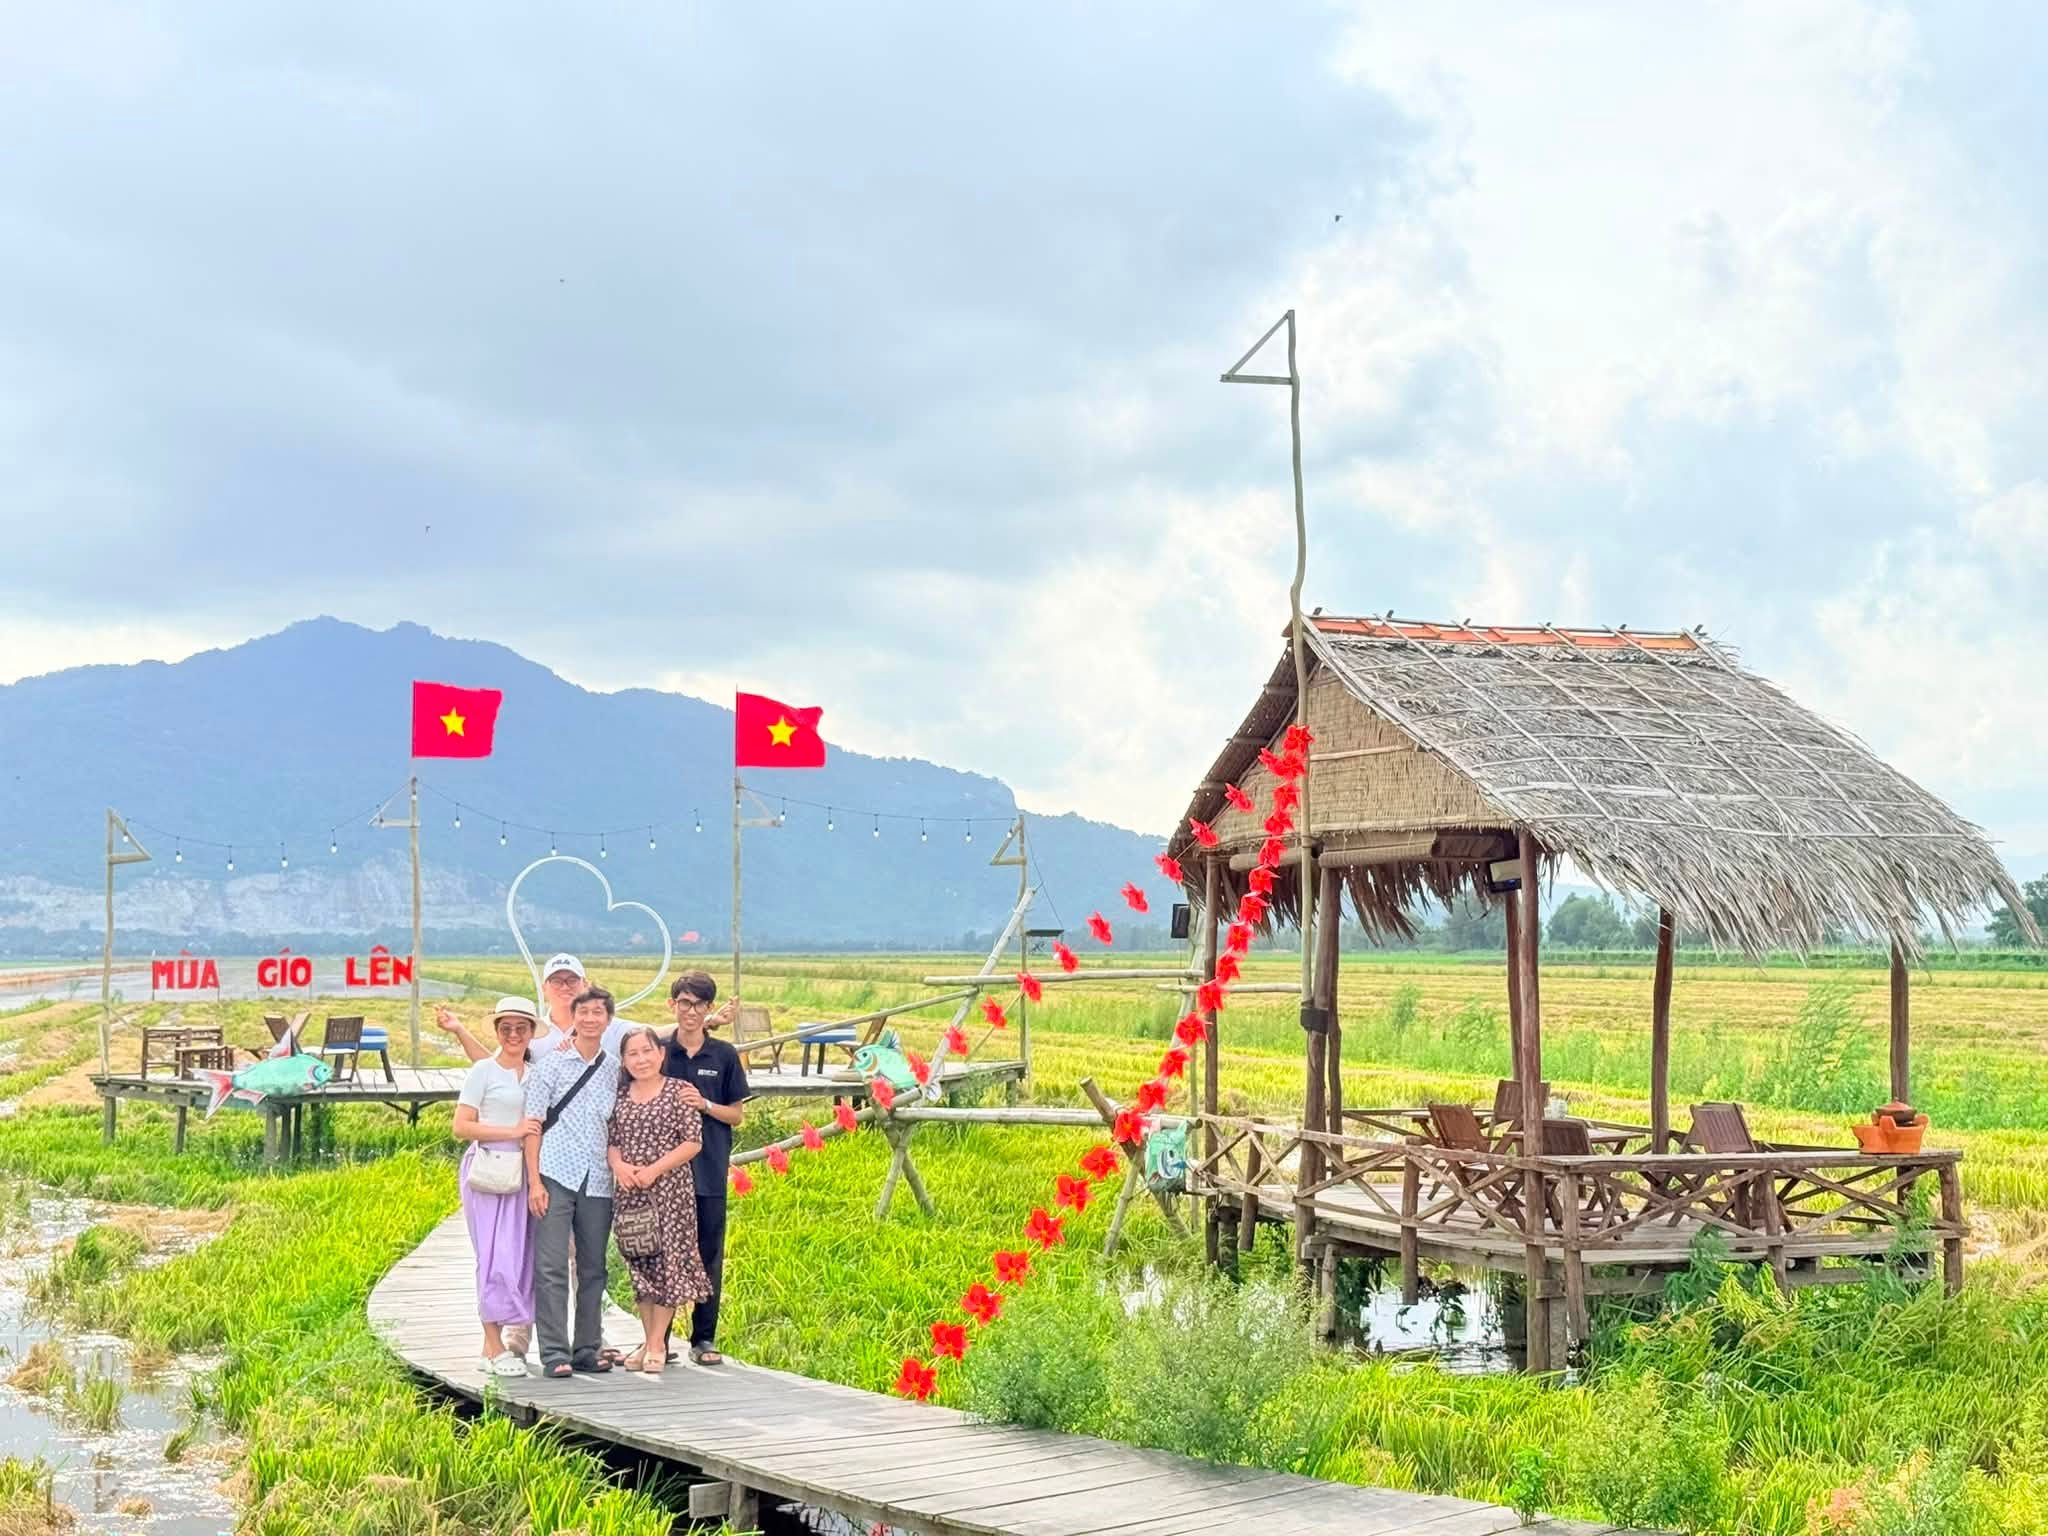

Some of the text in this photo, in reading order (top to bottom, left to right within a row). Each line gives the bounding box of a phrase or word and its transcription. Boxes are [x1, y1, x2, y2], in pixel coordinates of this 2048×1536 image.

[152, 944, 414, 989] MÙA GÍO LÊN
